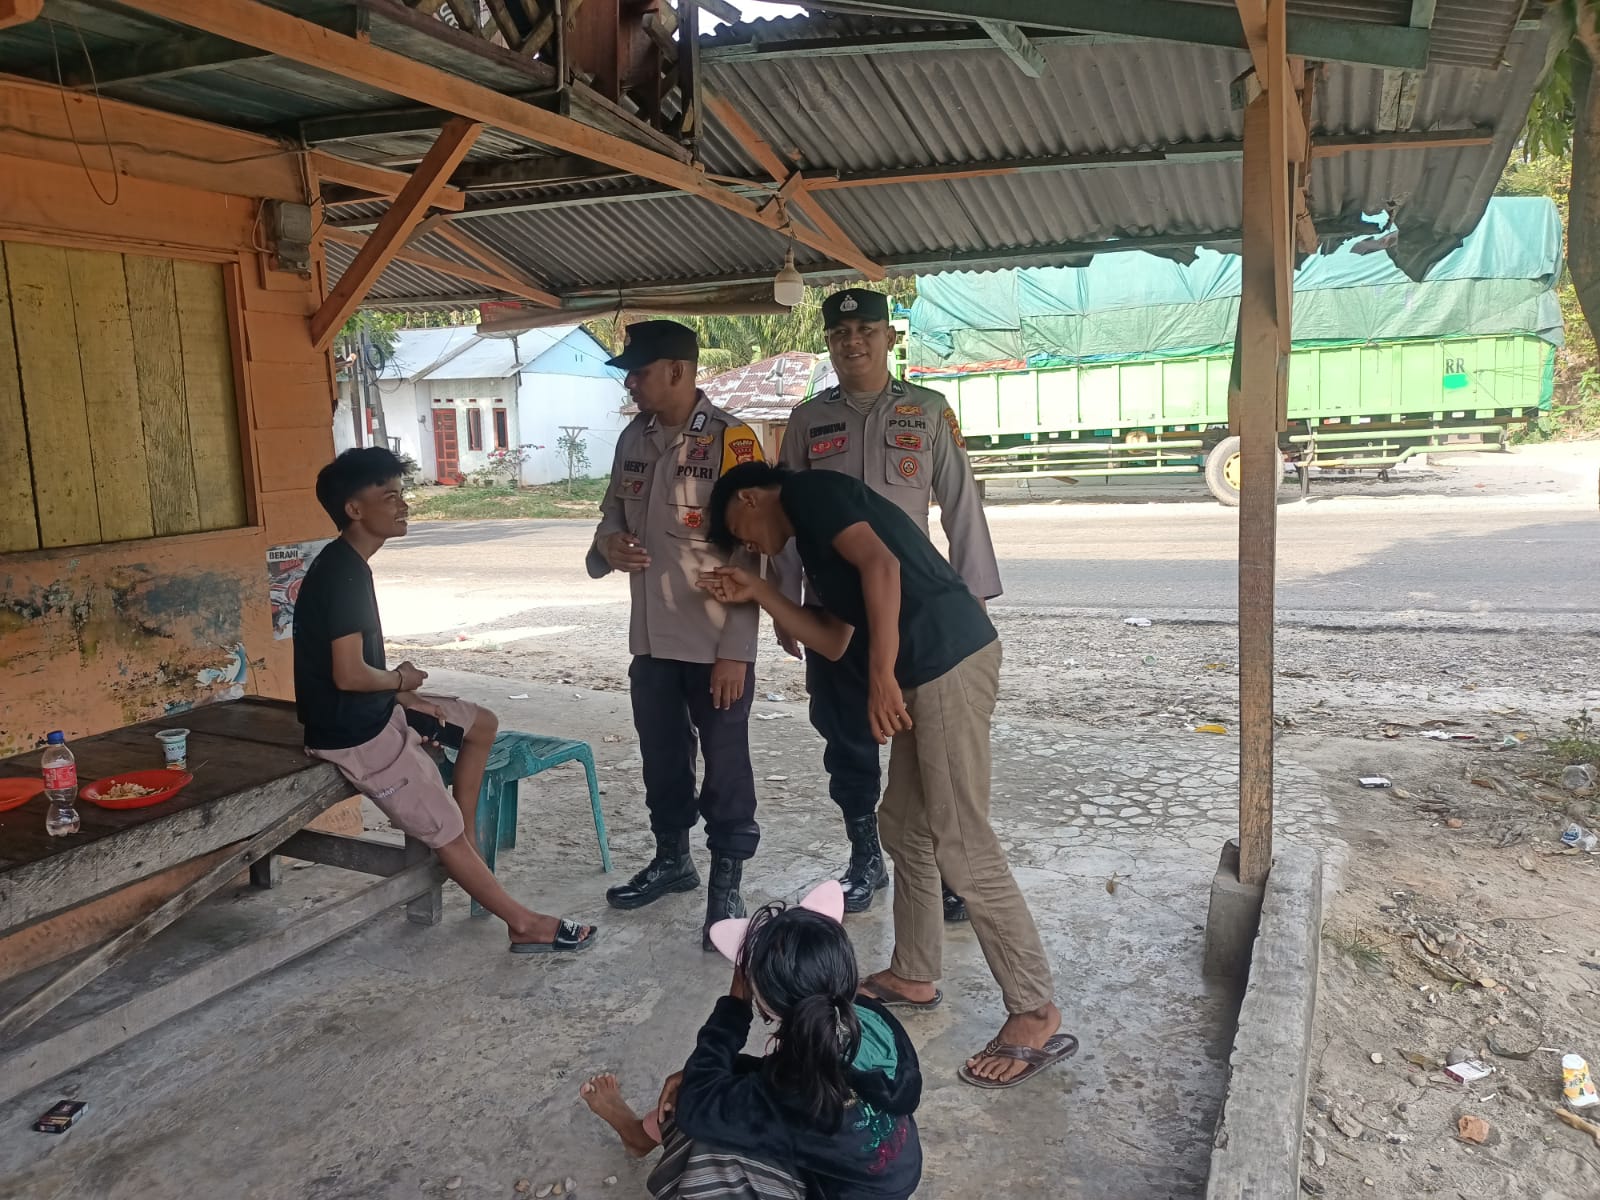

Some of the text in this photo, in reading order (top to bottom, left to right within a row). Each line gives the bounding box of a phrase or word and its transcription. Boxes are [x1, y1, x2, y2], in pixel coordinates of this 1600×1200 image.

[1445, 357, 1465, 374] RR
[888, 419, 926, 429] POLRI
[676, 465, 713, 479] POLRI
[269, 550, 298, 560] BERANI
